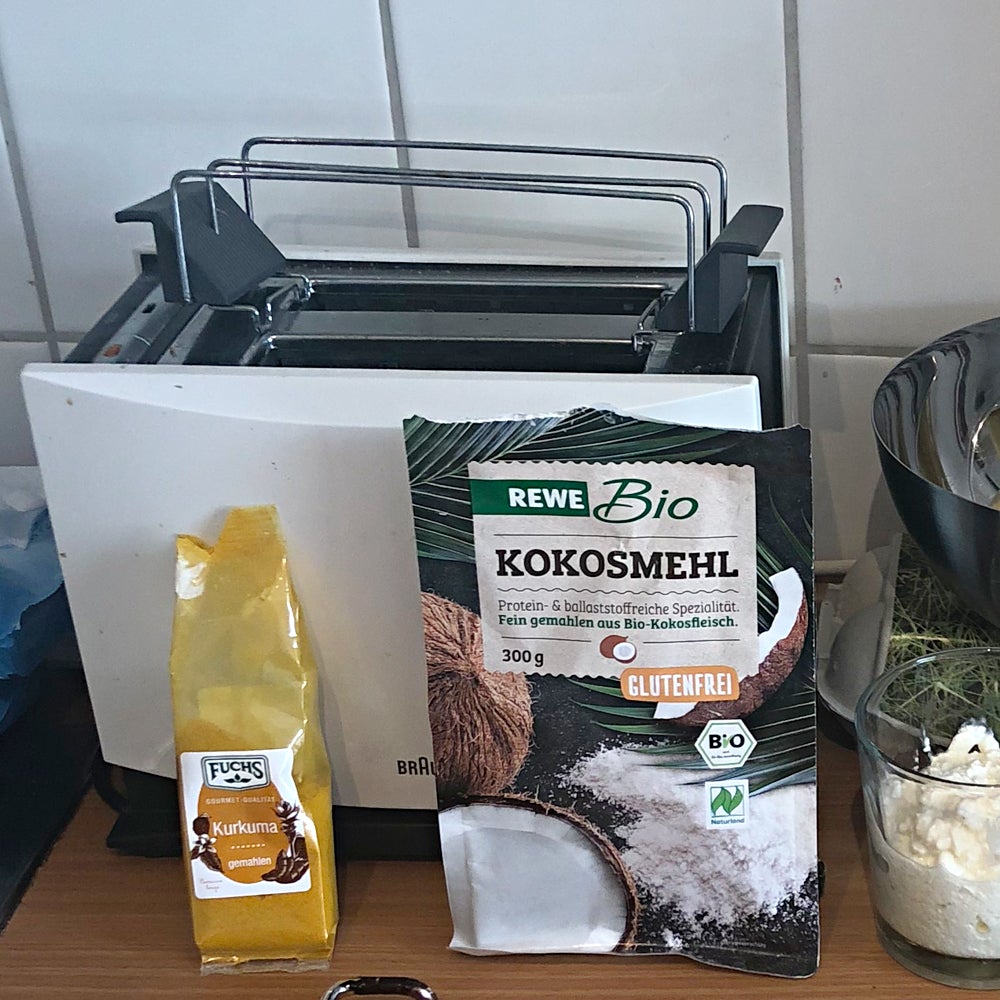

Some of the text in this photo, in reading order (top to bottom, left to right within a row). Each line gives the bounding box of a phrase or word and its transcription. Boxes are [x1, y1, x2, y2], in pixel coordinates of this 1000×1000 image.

[508, 478, 699, 524] REWE Bio
[495, 548, 739, 580] KOKOSMEHL
[498, 599, 740, 617] Protein- & ballaststoffreiche Spezialität.
[498, 614, 739, 630] Fein gemahlen aus Bio-Kokosfleisch.
[502, 649, 545, 667] 300 g
[628, 673, 733, 697] GLUTENFREI
[207, 760, 264, 780] FUCHS
[212, 820, 279, 837] Kurkuma
[710, 817, 746, 825] Naturland
[228, 856, 272, 870] gemahlen
